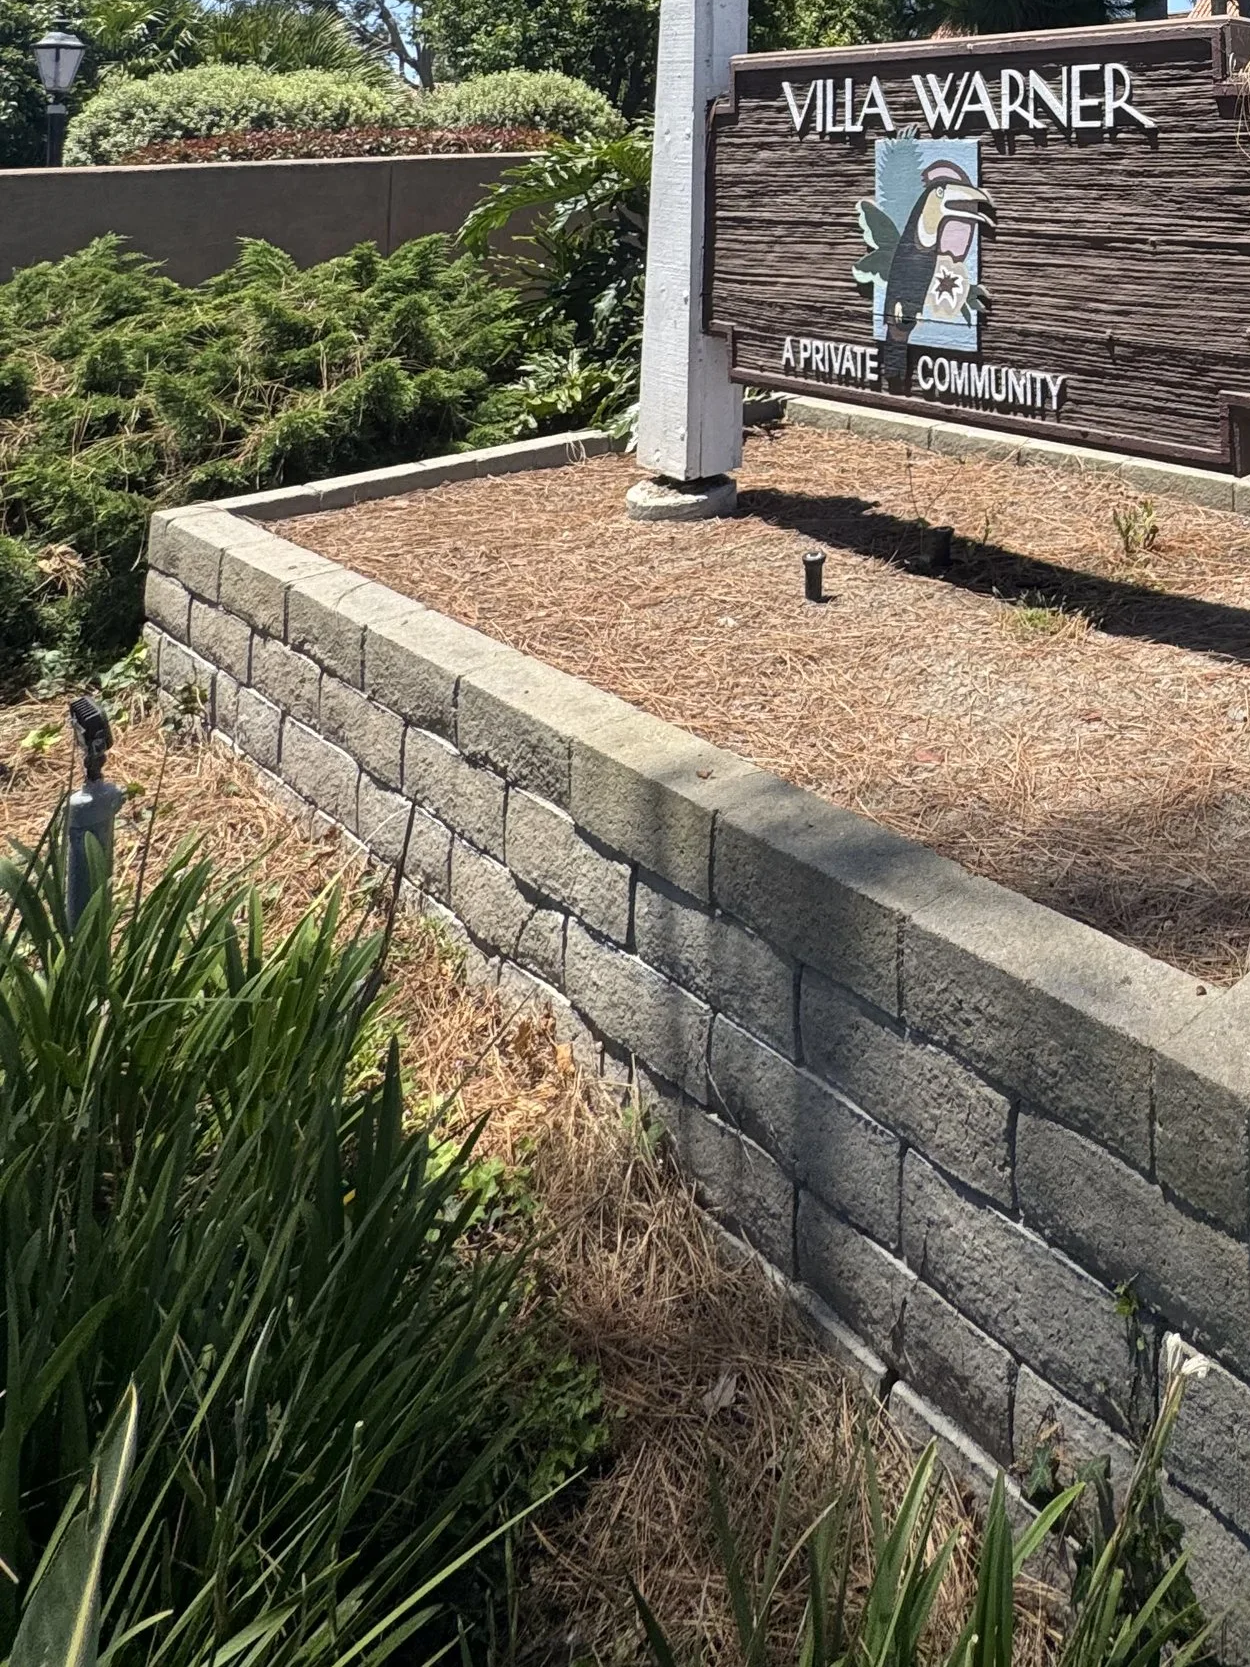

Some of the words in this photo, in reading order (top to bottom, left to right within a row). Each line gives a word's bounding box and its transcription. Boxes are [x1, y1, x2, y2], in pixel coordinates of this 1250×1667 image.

[781, 75, 895, 133] VILLA
[911, 62, 1158, 131] WARNER
[781, 336, 795, 364] A
[799, 336, 879, 382] PRIVATE
[917, 354, 1067, 411] COMMUNITY
